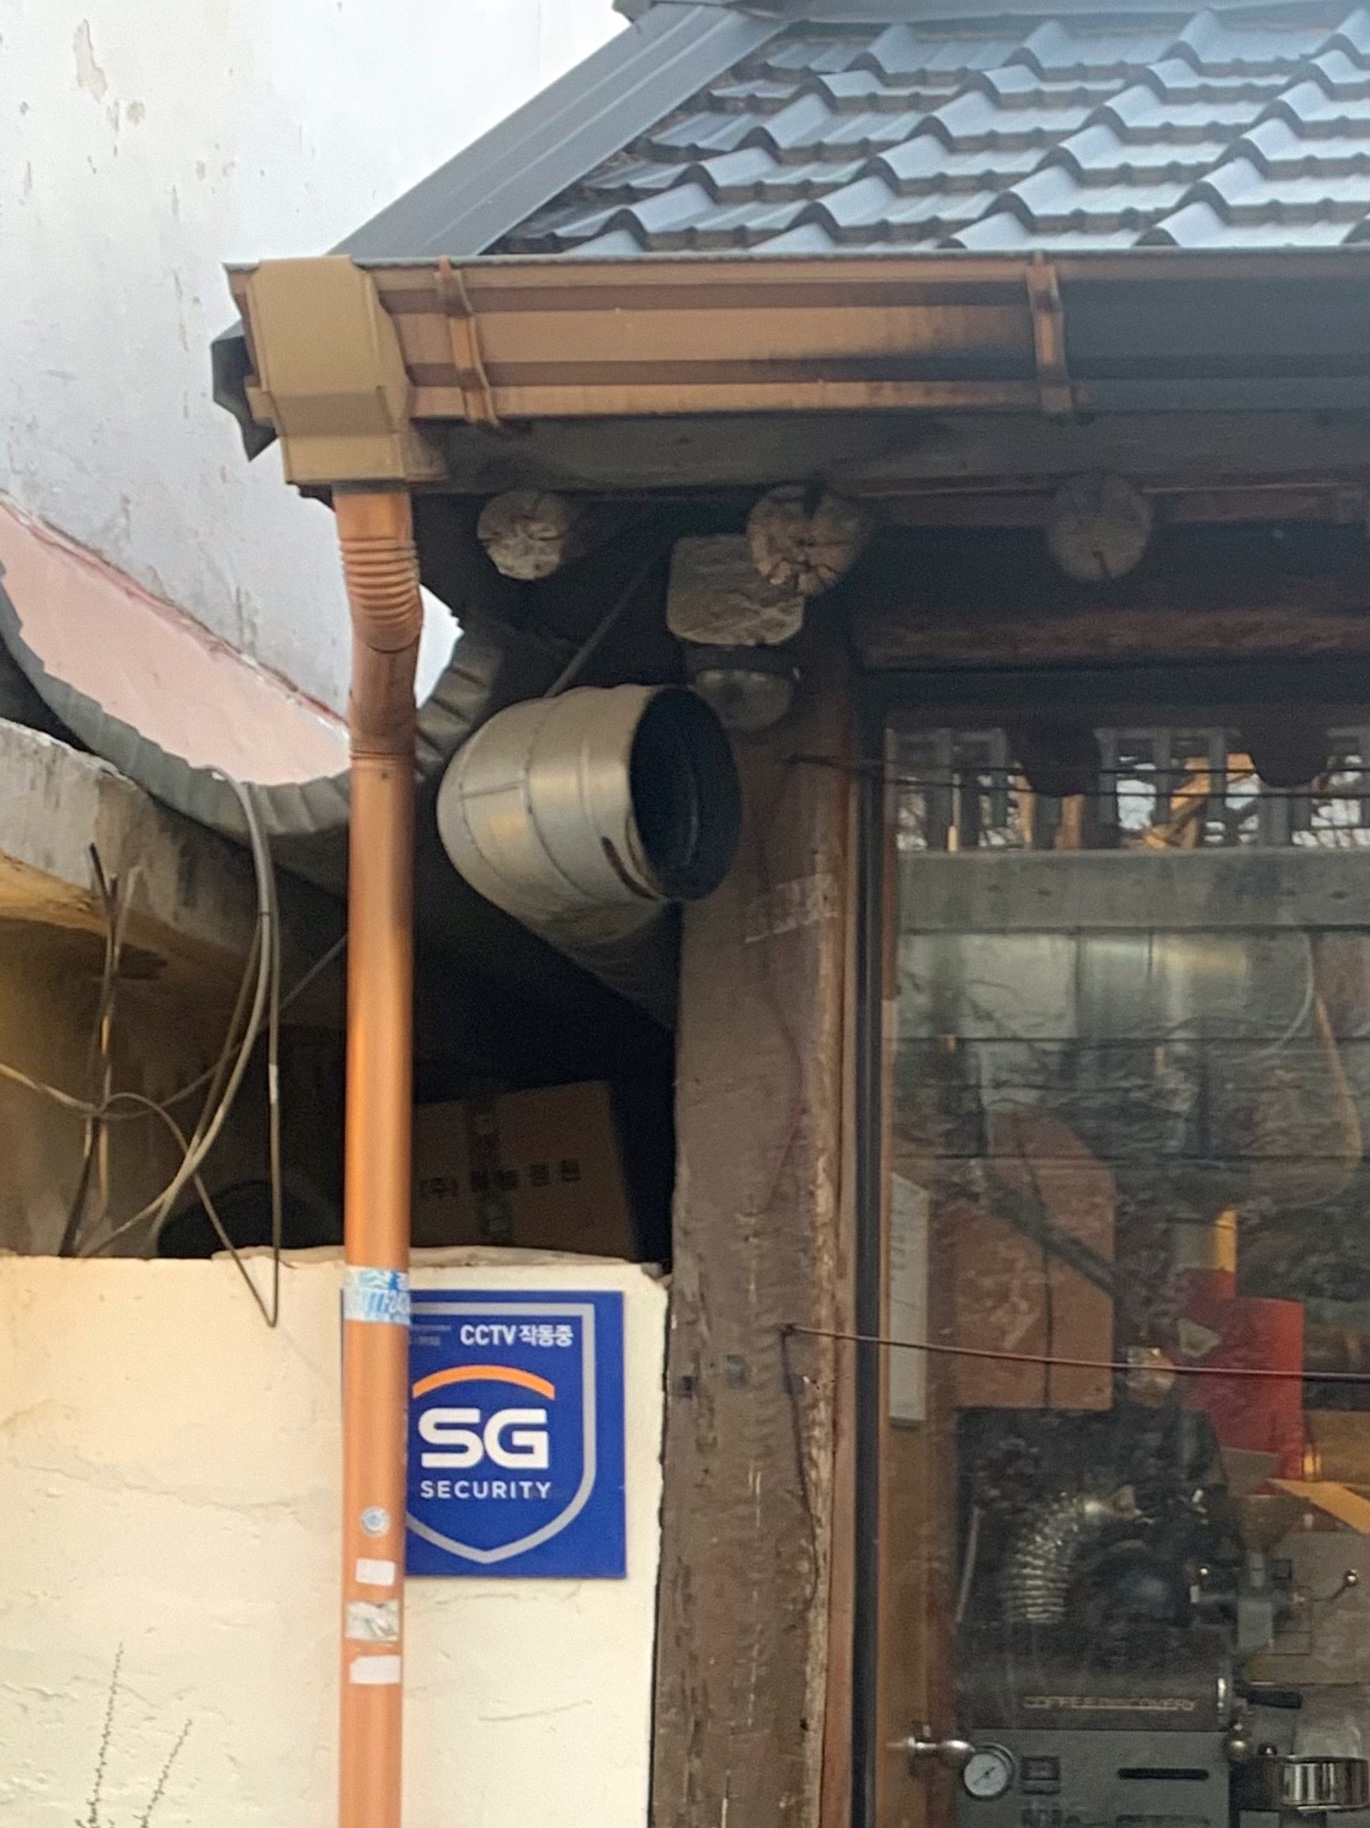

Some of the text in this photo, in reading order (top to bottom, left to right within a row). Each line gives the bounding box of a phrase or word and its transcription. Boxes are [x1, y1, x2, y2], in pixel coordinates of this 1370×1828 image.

[460, 1324, 517, 1346] CCTV
[518, 1324, 574, 1347] 작동중
[418, 1408, 550, 1469] SG
[420, 1480, 552, 1499] SECURITY
